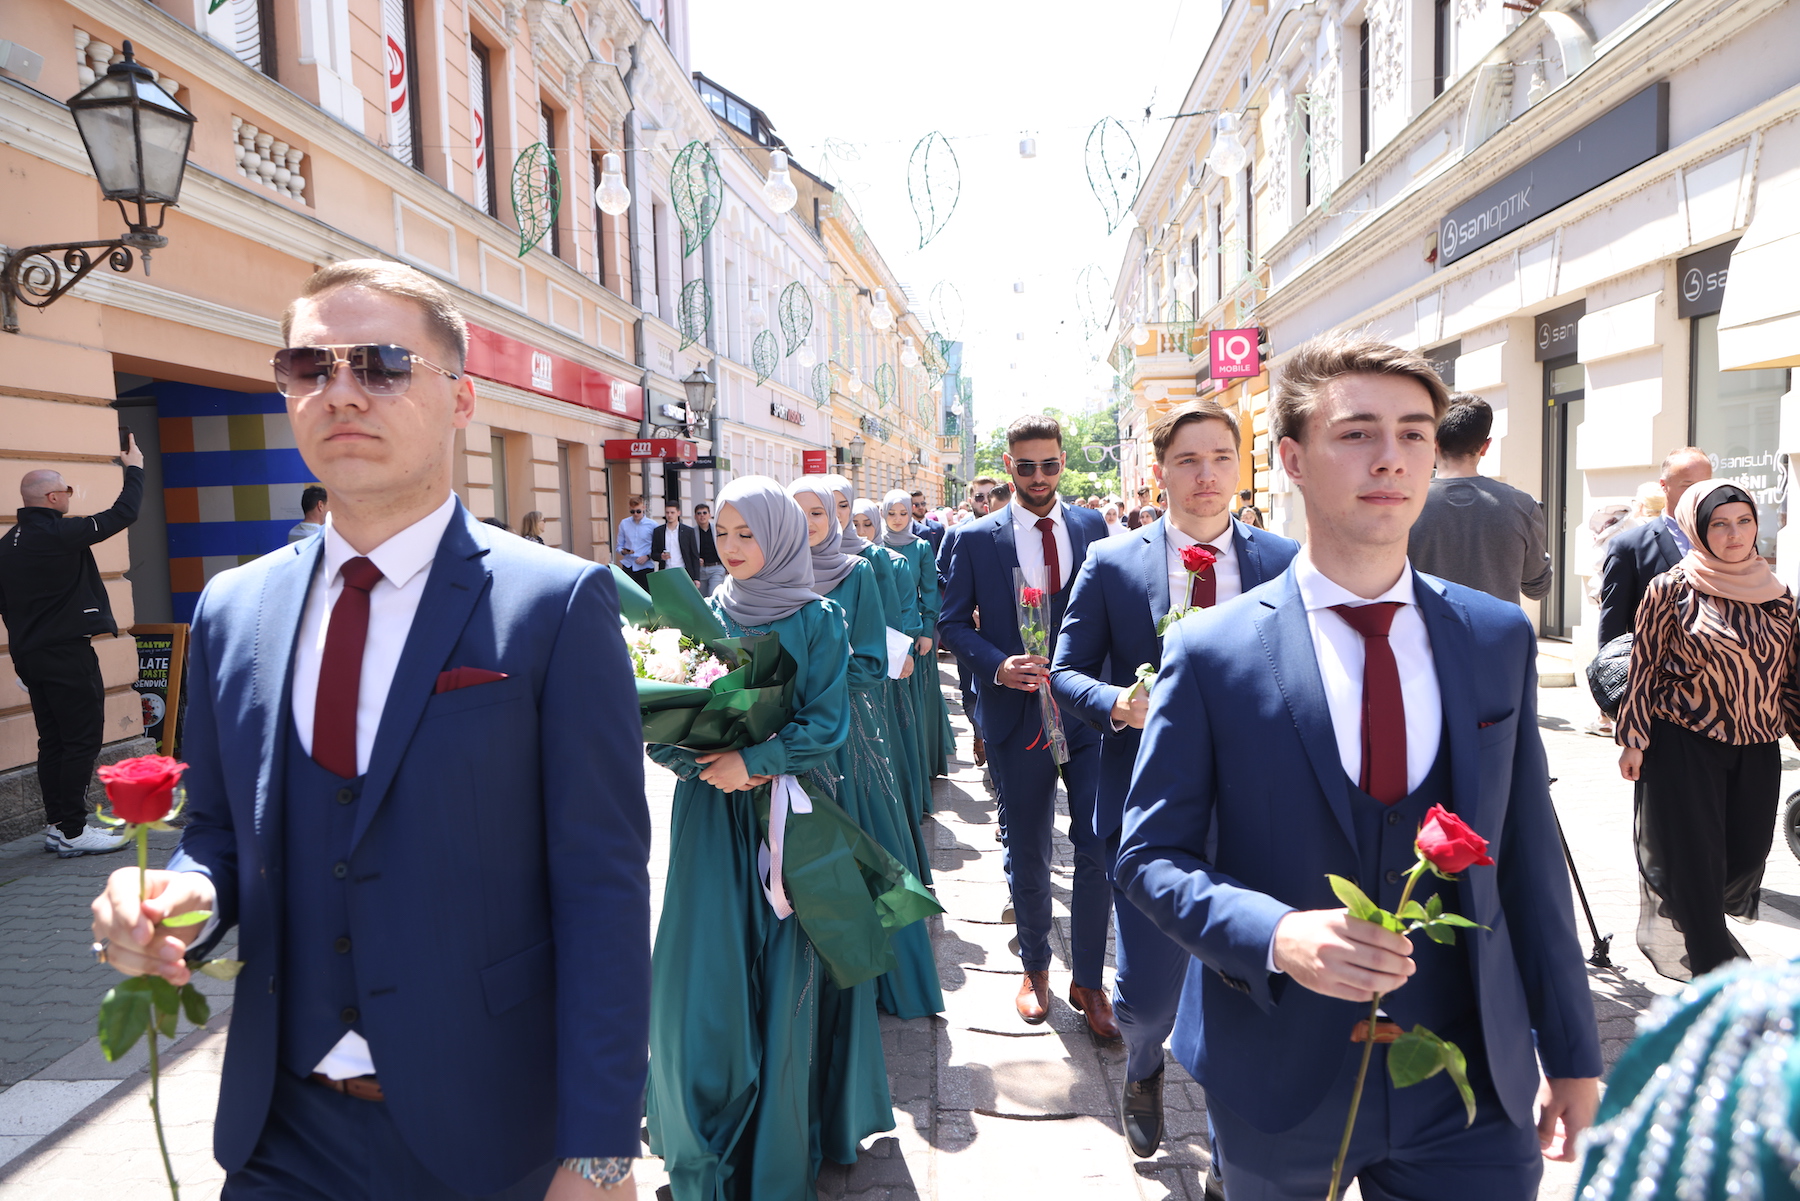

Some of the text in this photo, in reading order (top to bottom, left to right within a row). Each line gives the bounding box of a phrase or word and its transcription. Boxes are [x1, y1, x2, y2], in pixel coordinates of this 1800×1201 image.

[1218, 336, 1250, 364] IQ
[1219, 364, 1251, 373] MOBILE
[630, 442, 652, 453] cm
[140, 658, 168, 669] LATE
[142, 669, 167, 678] PASTE
[134, 678, 167, 688] SENDVIČI
